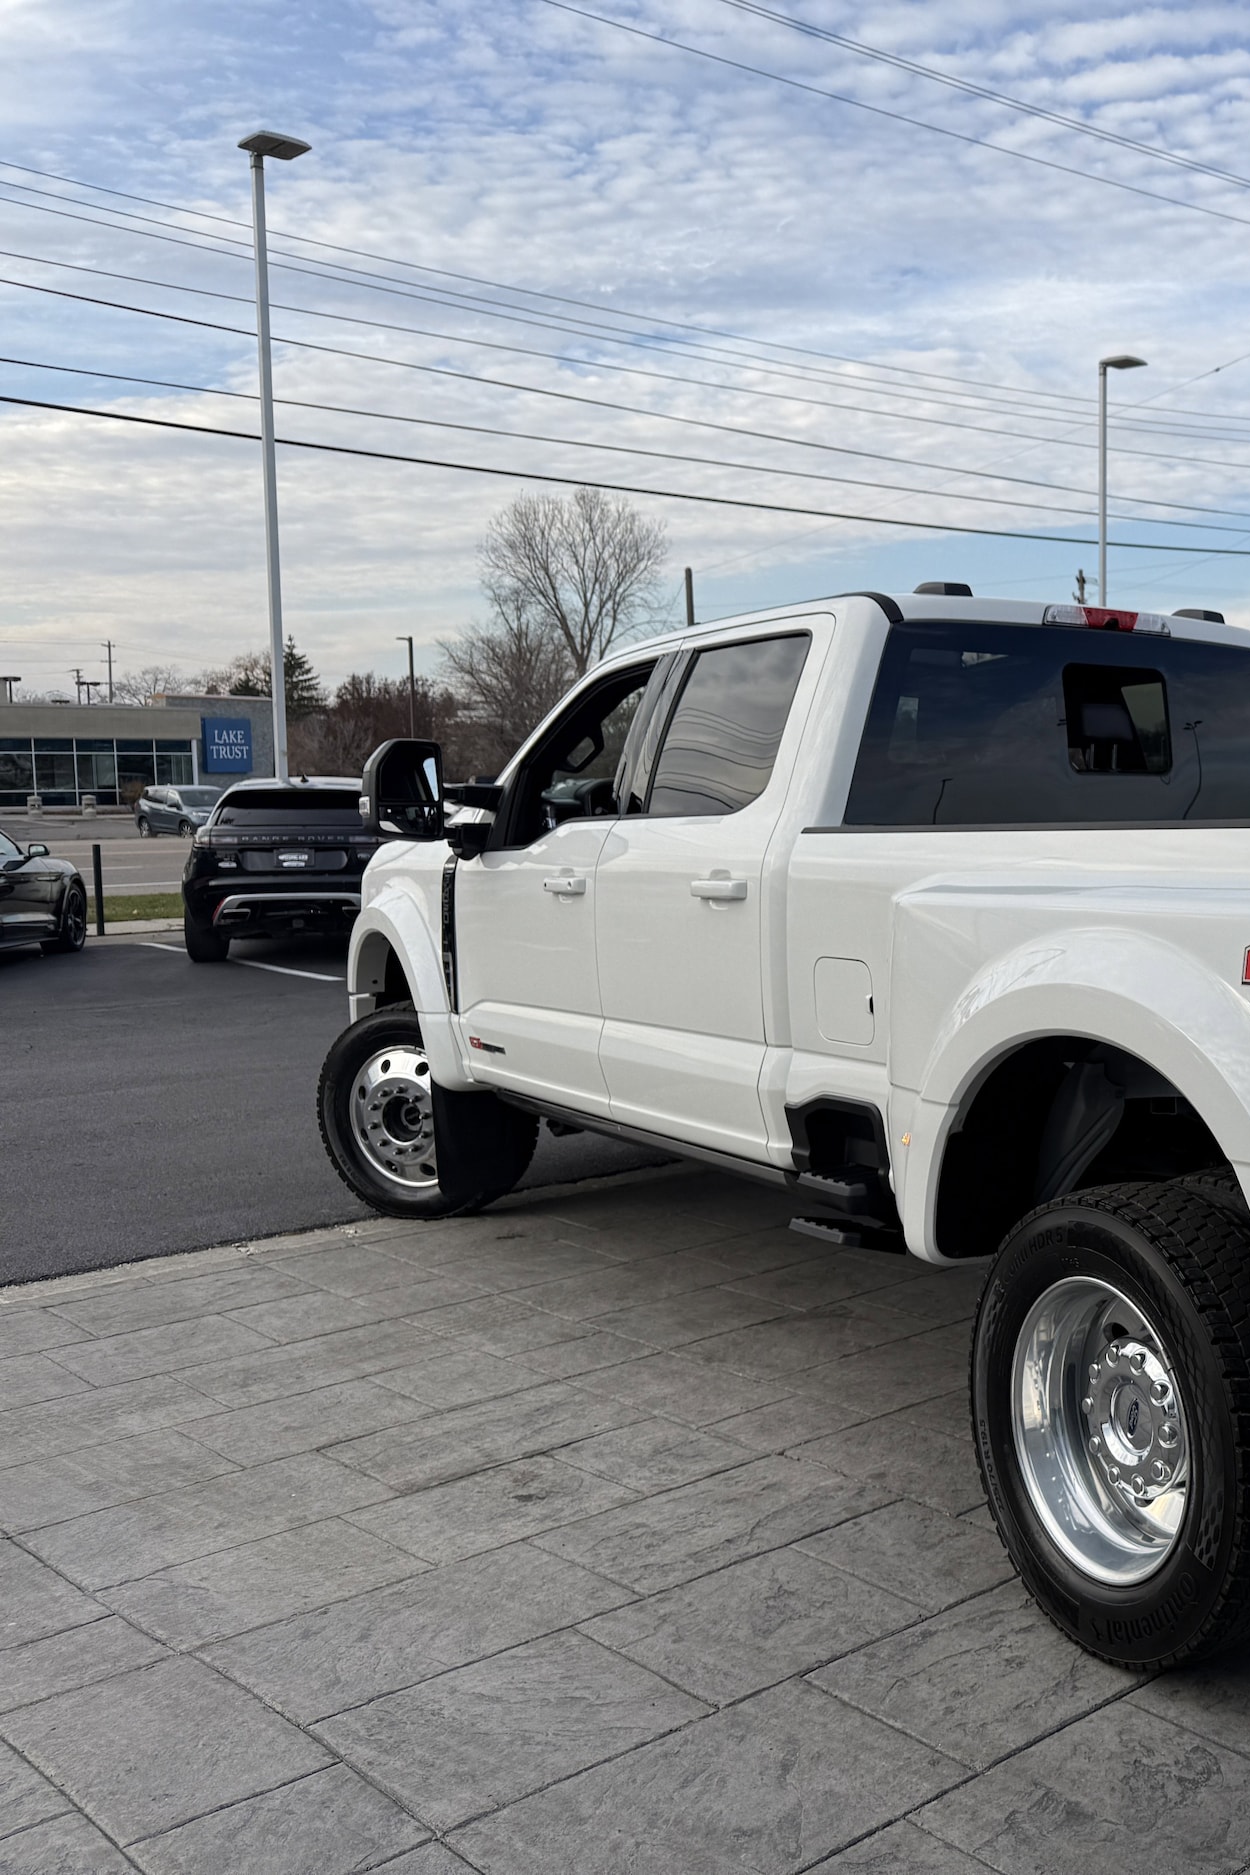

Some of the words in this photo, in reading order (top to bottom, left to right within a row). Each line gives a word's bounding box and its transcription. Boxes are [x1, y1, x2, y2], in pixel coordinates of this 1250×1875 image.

[214, 729, 245, 744] LAKE
[210, 745, 249, 760] TRUST
[1027, 1229, 1054, 1255] HDR
[1055, 1226, 1064, 1243] 5
[979, 1419, 989, 1447] 19.5
[984, 1449, 991, 1460] R
[986, 1462, 1005, 1513] 225/70
